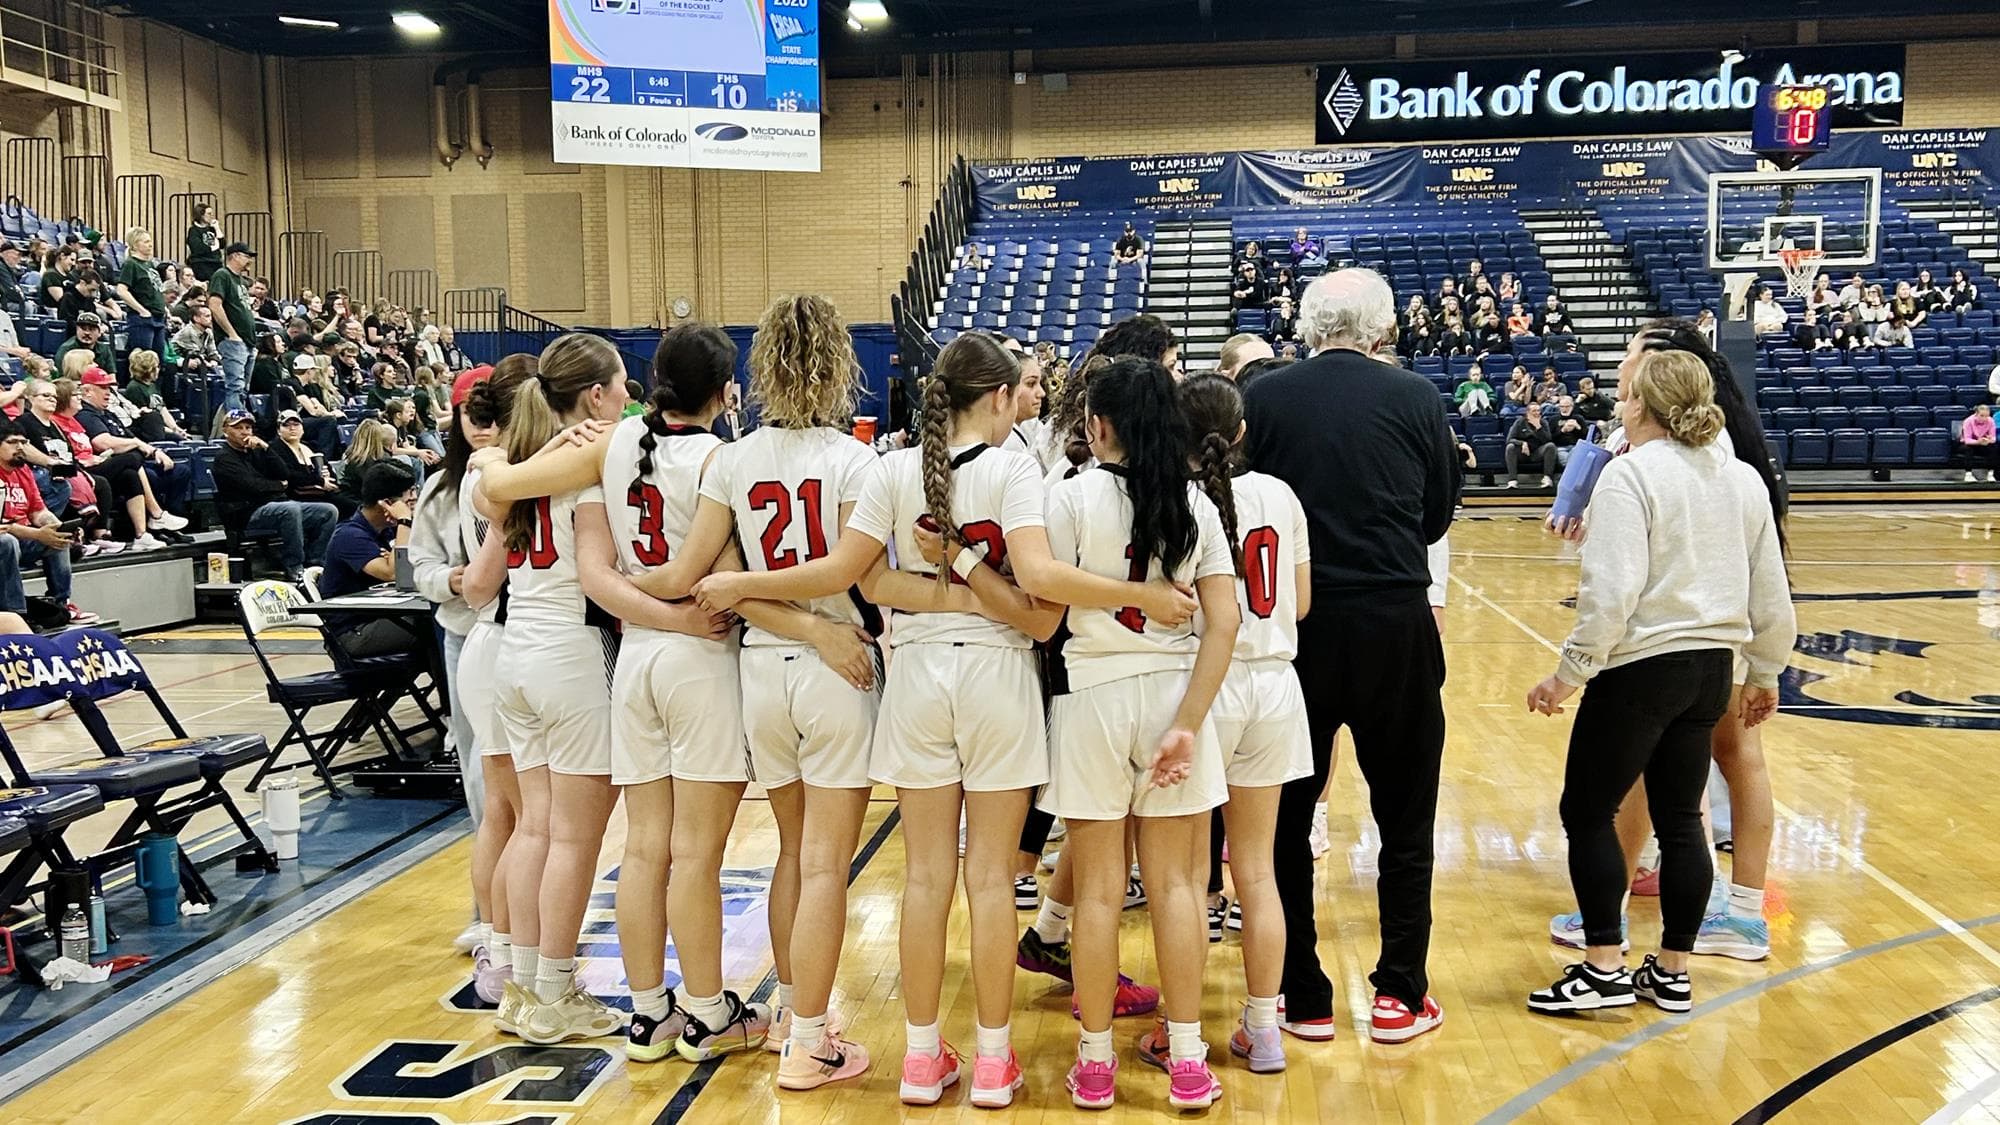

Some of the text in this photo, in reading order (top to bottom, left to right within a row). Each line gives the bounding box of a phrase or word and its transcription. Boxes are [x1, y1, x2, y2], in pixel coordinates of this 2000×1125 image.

[770, 13, 804, 40] CHSAA
[782, 45, 802, 54] STATE
[766, 56, 818, 66] CHAMPIONSHIPS
[577, 66, 602, 76] MHS
[717, 74, 739, 83] FHS
[571, 76, 611, 102] 22
[648, 77, 670, 86] 6:48
[711, 83, 748, 110] 10
[1369, 70, 1481, 120] Bank
[1482, 68, 1541, 117] of
[1547, 62, 1759, 114] Colorado
[638, 96, 682, 106] 0 Fouls 0
[1775, 88, 1827, 111] 6:48
[571, 125, 687, 144] Bank of Colorado
[1794, 110, 1814, 144] 0
[1727, 139, 1752, 149] DAN
[1882, 131, 1986, 144] DAN CAPLIS LAW
[1422, 146, 1521, 158] DAN CAPLIS LAW
[1573, 142, 1674, 154] DAN CAPLIS LAW
[1130, 156, 1225, 170] DAN CAPLIS LAW
[1275, 152, 1372, 164] DAN CAPLIS LAW
[1912, 152, 1958, 168] UNC
[988, 164, 1081, 178] DAN CAPLIS LAW
[1452, 167, 1494, 182] UNC
[1602, 162, 1646, 177] UNC
[1902, 170, 1939, 178] OFFICIAL
[1159, 178, 1200, 193] UNC
[1304, 172, 1345, 187] UNC
[1016, 185, 1056, 200] UNC
[627, 482, 669, 567] 3
[748, 478, 829, 571] 21
[506, 496, 559, 569] 0
[70, 649, 141, 686] CHSAA
